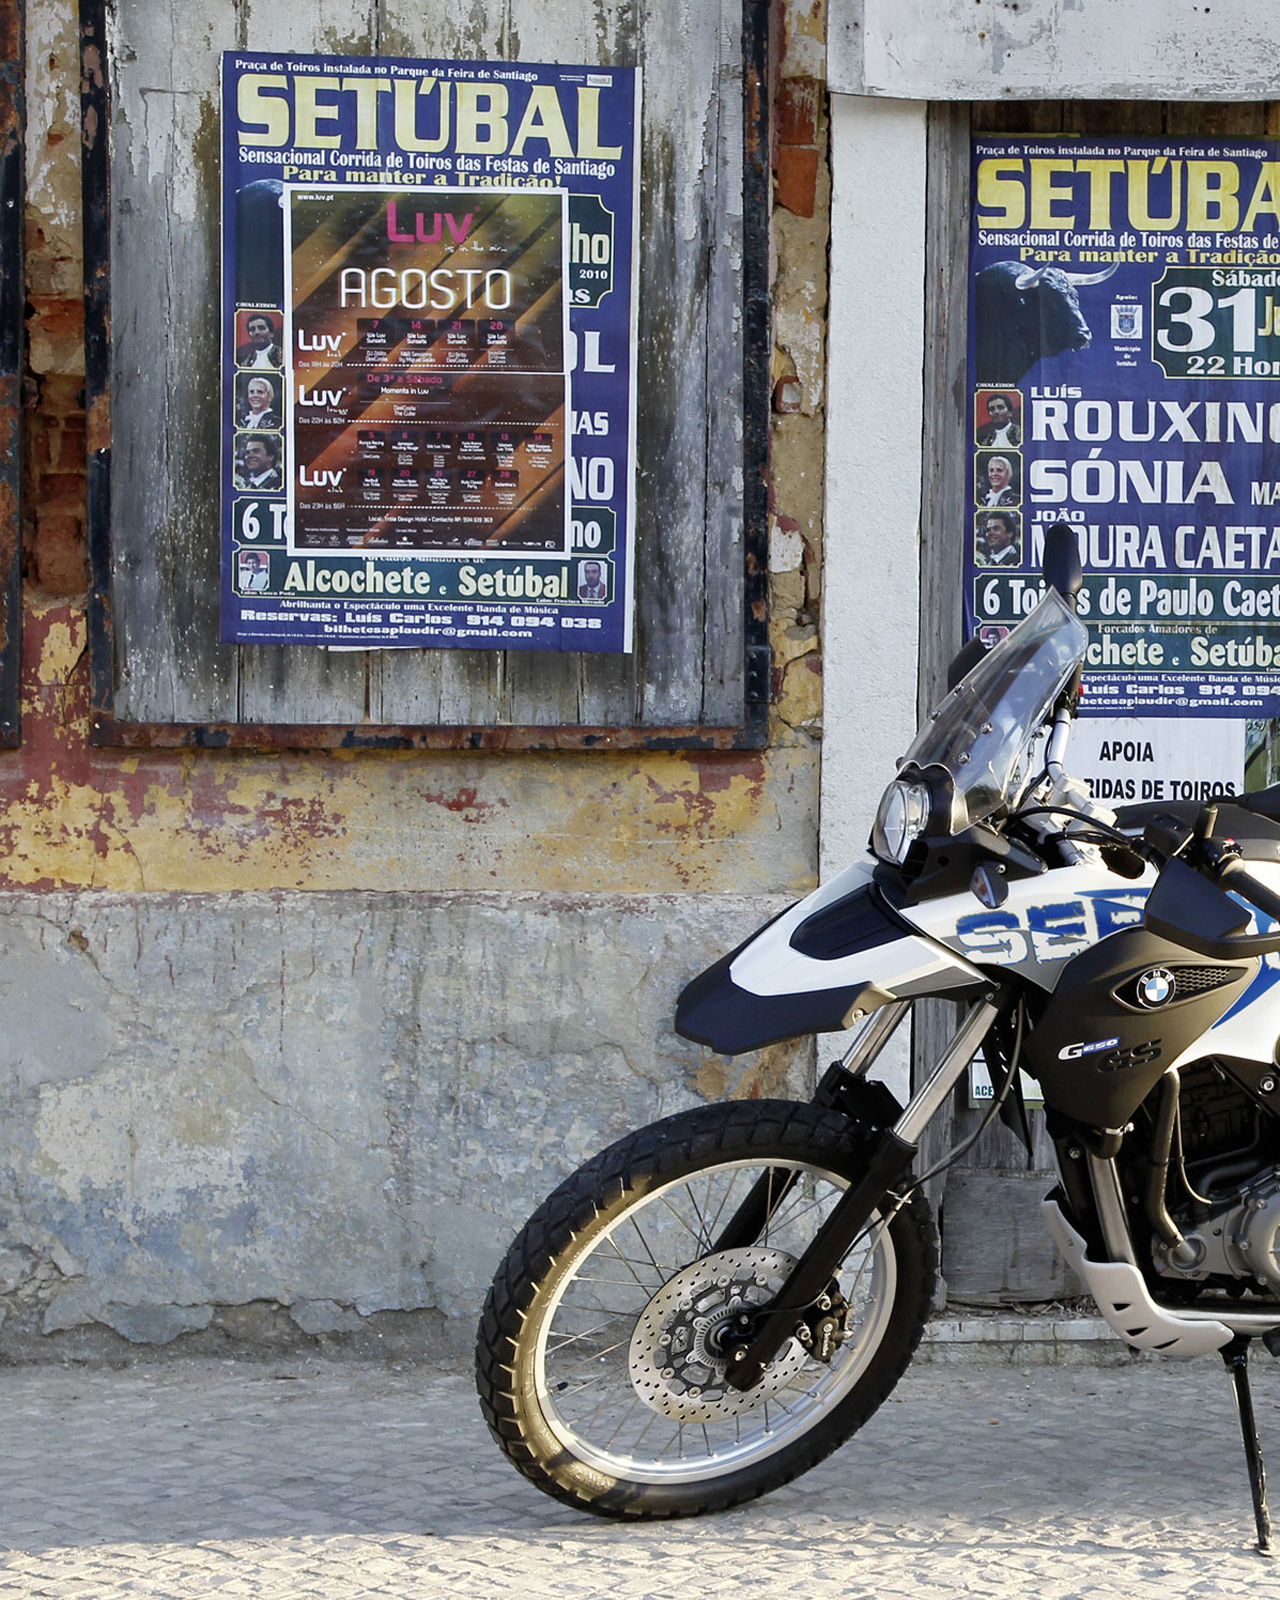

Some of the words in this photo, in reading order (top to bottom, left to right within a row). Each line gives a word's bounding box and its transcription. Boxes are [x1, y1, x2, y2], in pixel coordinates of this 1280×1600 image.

[235, 59, 267, 71] Praça
[270, 61, 284, 71] de
[286, 62, 321, 73] Toiros
[323, 63, 372, 74] instalada
[374, 66, 387, 75] no
[390, 66, 429, 79] Parque
[432, 67, 445, 77] da
[448, 68, 474, 78] Feira
[477, 69, 491, 79] de
[493, 70, 538, 82] Santiago
[236, 73, 623, 160] SETÚBAL
[239, 147, 325, 165] Sensacional
[330, 148, 382, 167] Corrida
[386, 151, 403, 168] de
[407, 152, 452, 170] Toiros
[456, 154, 482, 171] das
[486, 155, 529, 173] Festas
[533, 156, 550, 174] de
[554, 157, 615, 179] Santiago
[297, 194, 334, 202] www.luv.pt
[386, 201, 474, 244] Luv
[1020, 247, 1071, 262] Para
[1079, 249, 1159, 263] manter
[1166, 252, 1180, 264] a
[580, 270, 608, 279] 2010
[340, 267, 511, 310] AGOSTO
[373, 321, 379, 329] 7
[452, 322, 461, 330] 21
[490, 322, 503, 330] 28
[1156, 286, 1255, 352] 31
[299, 329, 342, 350] Luv
[1187, 356, 1226, 375] 22
[367, 374, 380, 382] De
[407, 374, 442, 384] Sábado
[299, 385, 342, 406] Luv
[381, 387, 408, 395] Moments
[1031, 385, 1082, 398] LUÍS
[300, 465, 343, 487] Luv
[1030, 448, 1235, 504] SÓNIA
[1031, 508, 1085, 522] JOÃO
[284, 561, 430, 594] Alcochete
[439, 584, 447, 595] e
[458, 565, 568, 598] Setúbal
[983, 579, 1000, 615] 6
[1009, 578, 1091, 616] Tois
[1100, 578, 1131, 616] de
[1139, 576, 1212, 617] Paulo
[280, 600, 331, 610] Abrilhanta
[343, 601, 400, 612] Espectáculo
[403, 604, 425, 612] uma
[428, 603, 474, 613] Excelente
[476, 605, 506, 614] Banda
[509, 606, 521, 615] de
[524, 605, 559, 615] Música
[241, 610, 337, 623] Reservas:
[346, 610, 382, 624] Luís
[389, 613, 452, 625] Carlos
[467, 615, 505, 626] 914
[511, 616, 555, 627] 094
[561, 617, 601, 629] 038
[1087, 635, 1163, 666] chete
[1172, 656, 1179, 666] e
[1100, 742, 1154, 762] APOIA
[1143, 780, 1163, 800] DE
[1169, 779, 1235, 800] TOIROS
[1140, 969, 1174, 984] BMW
[1097, 1039, 1162, 1073] GS
